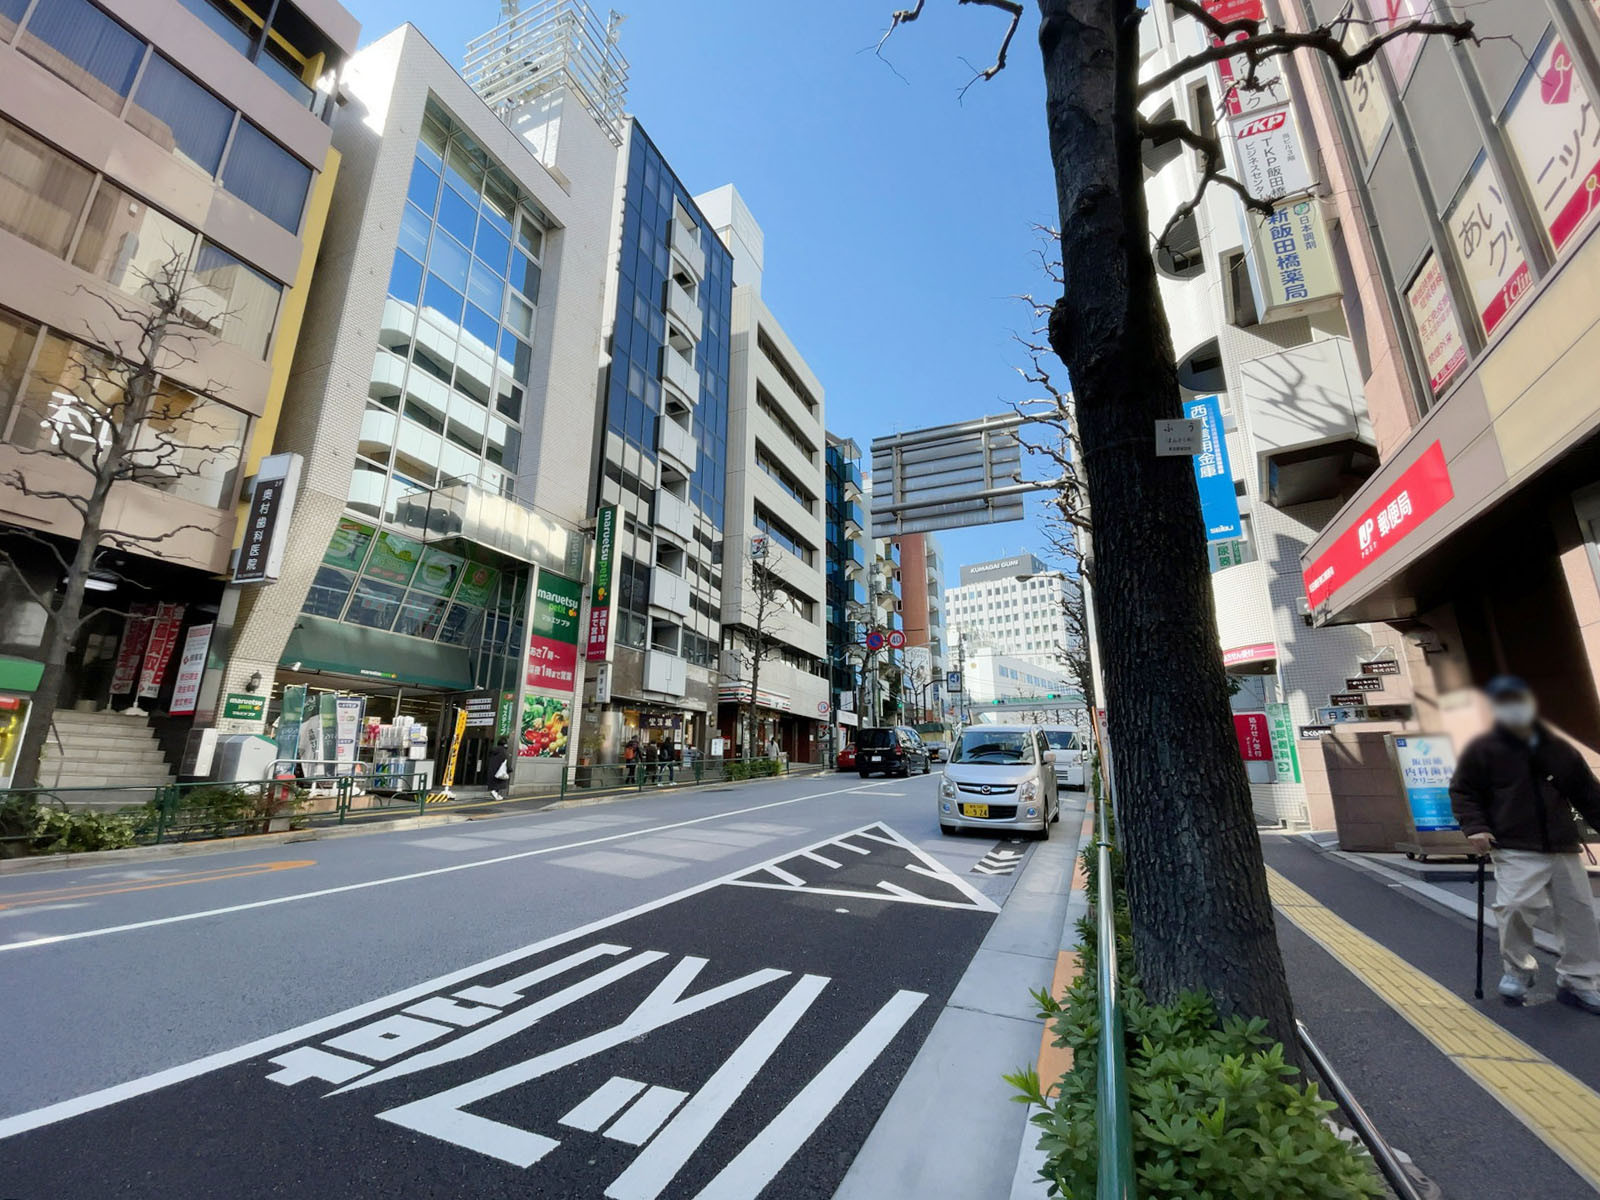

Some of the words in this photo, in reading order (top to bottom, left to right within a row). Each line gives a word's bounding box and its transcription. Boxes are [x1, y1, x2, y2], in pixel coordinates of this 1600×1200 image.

[1241, 115, 1285, 138] TKP
[1299, 211, 1317, 250] 日本調剤
[1267, 203, 1308, 301] 新飯田橋薬局
[1377, 490, 1413, 538] 郵便局
[601, 510, 612, 561] maruetsu
[970, 562, 1000, 574] KUMAGAI
[1000, 559, 1019, 568] GUMI
[537, 588, 579, 609] maruetsu
[547, 603, 566, 614] petit
[891, 634, 903, 645] 40
